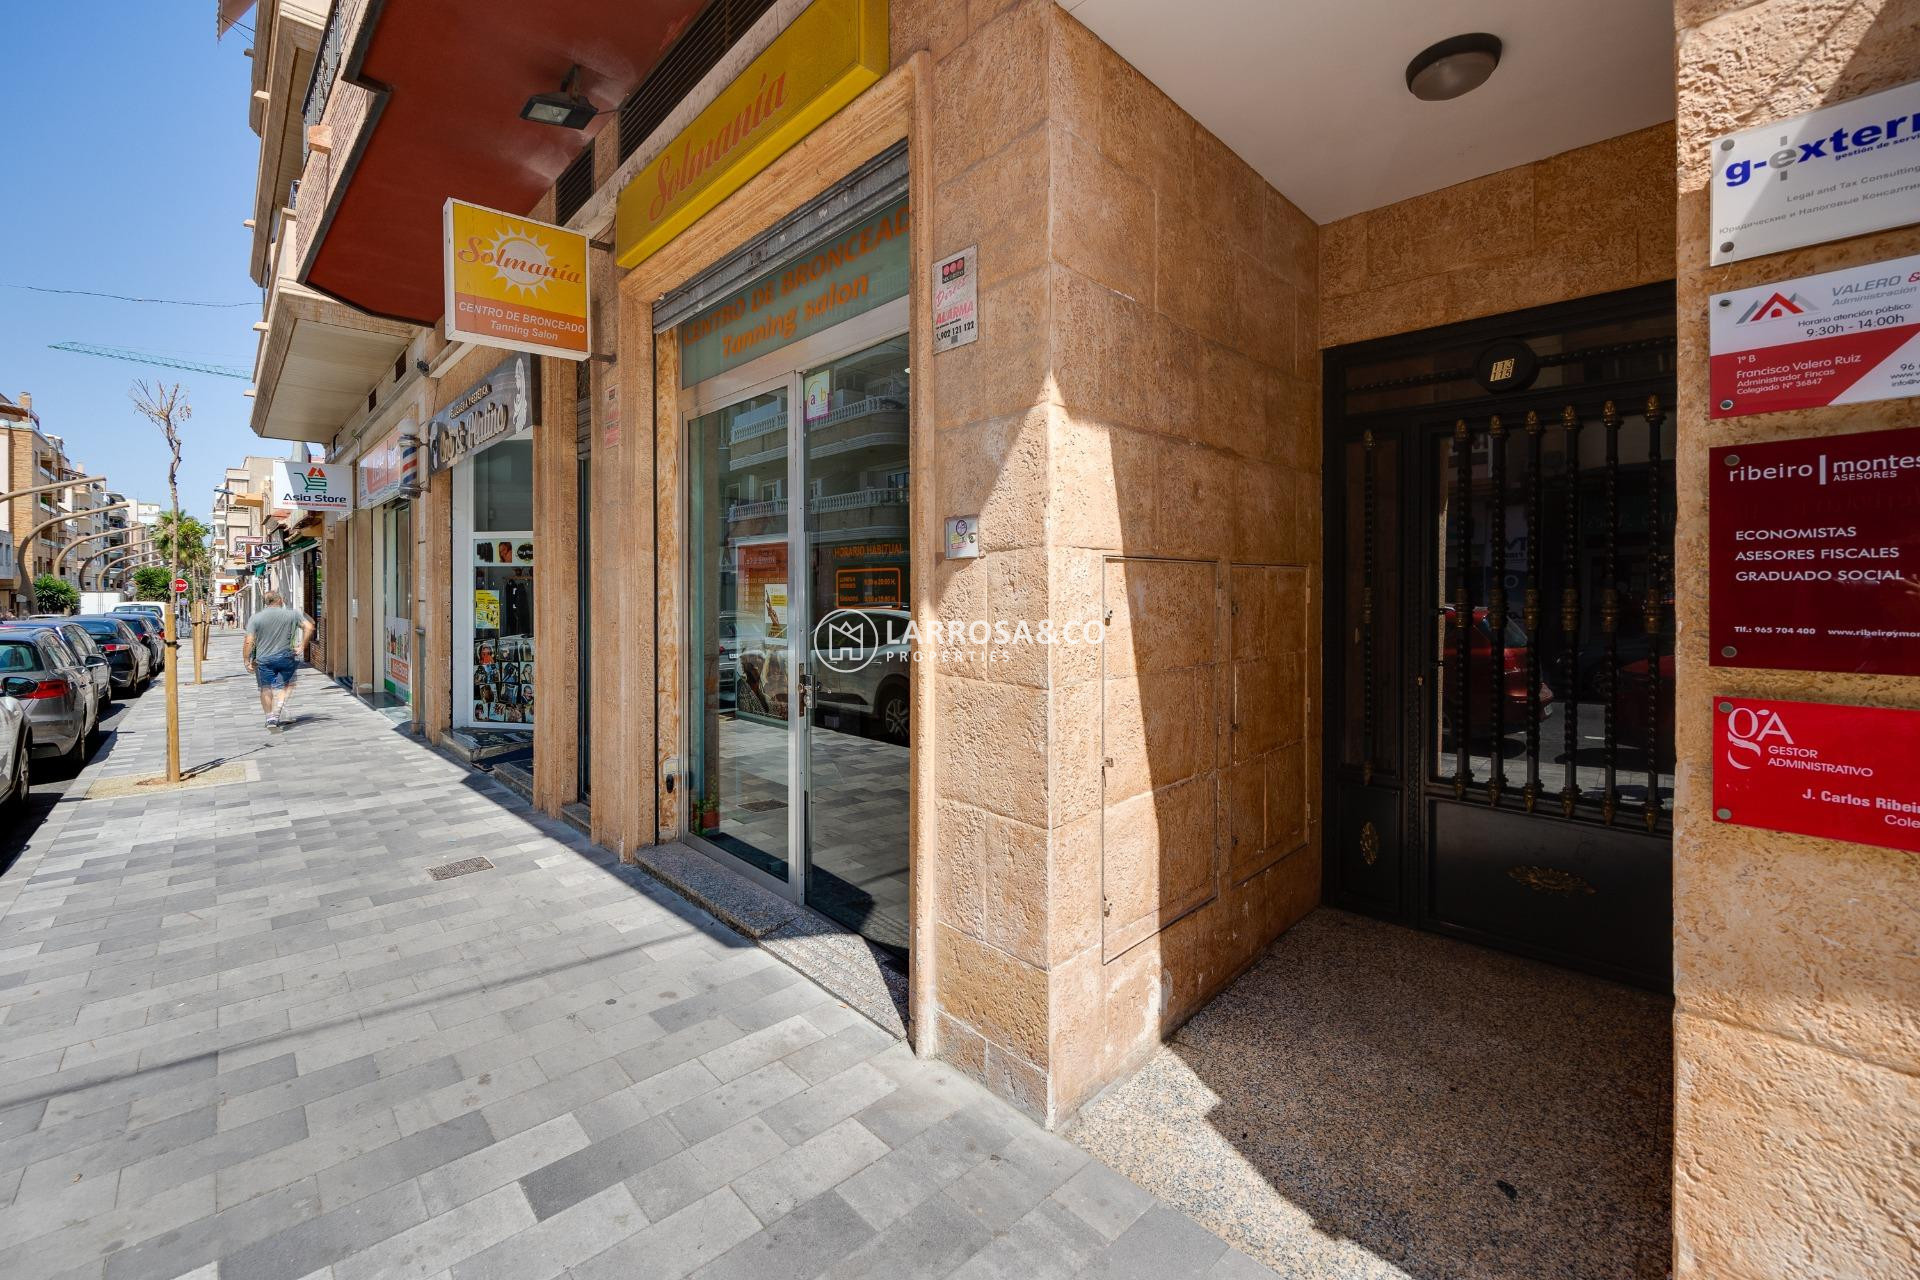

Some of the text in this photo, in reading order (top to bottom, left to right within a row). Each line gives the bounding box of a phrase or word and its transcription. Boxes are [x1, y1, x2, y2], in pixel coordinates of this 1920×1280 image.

[1786, 189, 1814, 202] Legal
[1817, 184, 1836, 196] and
[1840, 181, 1857, 190] Tax
[458, 236, 583, 284] Solmanía
[1832, 275, 1901, 297] VALERO
[1832, 285, 1918, 306] Administración
[459, 301, 585, 334] CENTRO DE BRONCEADO
[683, 299, 746, 347] CENTRO
[751, 279, 775, 314] DE
[1798, 316, 1831, 328] Horario
[1833, 309, 1873, 322] atención
[491, 320, 558, 341] Tanning Salon
[721, 305, 798, 358] Tanning
[940, 329, 951, 340] 902
[952, 325, 962, 336] 121
[964, 320, 975, 332] 122
[1806, 324, 1844, 338] 9:30h
[1858, 314, 1904, 329] 14:00h
[1736, 354, 1861, 379] Francisco Valero Ruiz
[1749, 354, 1756, 363] B
[1900, 362, 1915, 371] 96
[1737, 368, 1835, 388] Administrador Fincas
[1737, 383, 1780, 395] Colegiado
[1796, 378, 1823, 388] 36847
[1729, 463, 1813, 482] ribeiro
[1833, 470, 1897, 482] ASESORES
[283, 493, 347, 503] Asia Store
[1736, 526, 1857, 541] ECONOMISTAS
[1735, 547, 1900, 561] ASESORES FISCALES
[1735, 570, 1905, 582] GRADUADO SOCIAL
[1755, 626, 1772, 634] 965
[1768, 745, 1818, 759] GESTOR
[1768, 758, 1873, 777] ADMINISTRATIVO
[1802, 788, 1816, 800] J.
[1821, 790, 1870, 807] Carlos
